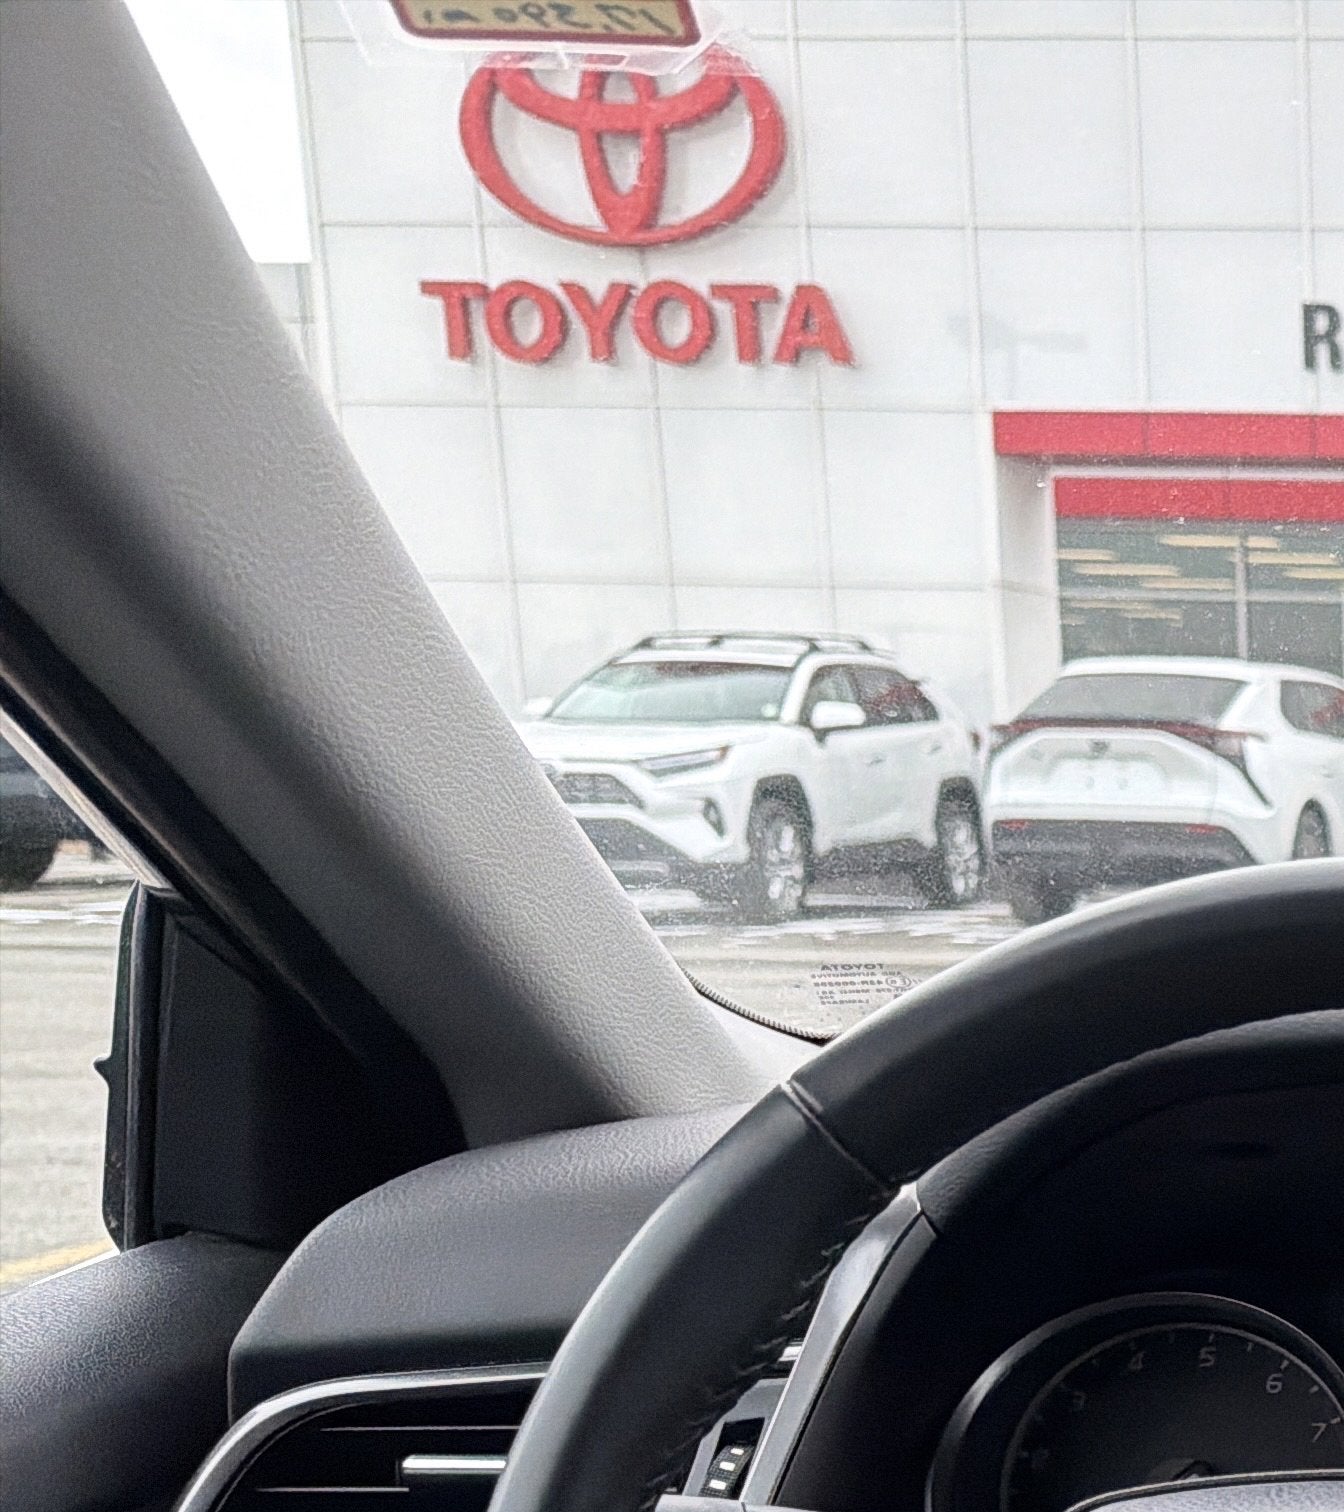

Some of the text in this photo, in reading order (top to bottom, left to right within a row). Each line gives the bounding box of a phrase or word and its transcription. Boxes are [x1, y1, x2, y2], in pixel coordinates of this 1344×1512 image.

[419, 279, 858, 366] TOYOTA
[1198, 1346, 1218, 1369] 5
[1265, 1373, 1283, 1394] 6
[1310, 1422, 1328, 1443] 7
